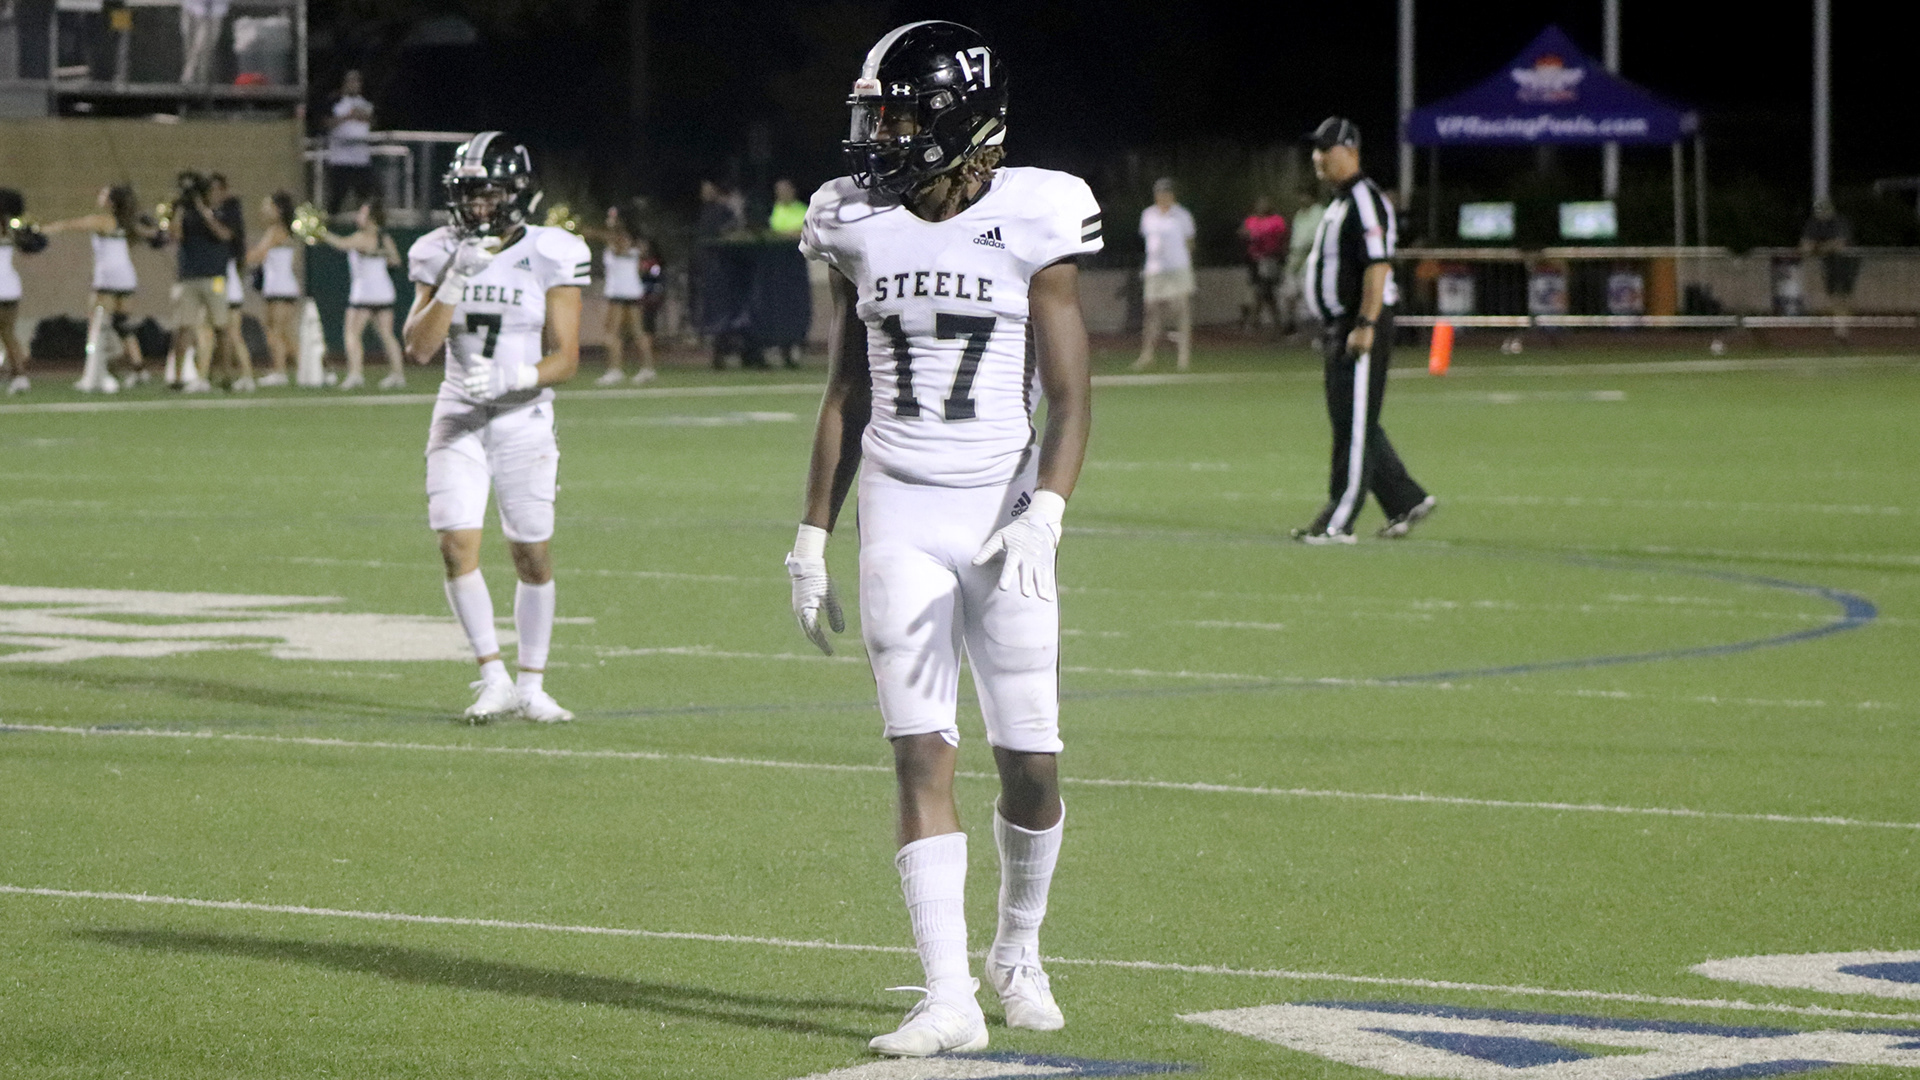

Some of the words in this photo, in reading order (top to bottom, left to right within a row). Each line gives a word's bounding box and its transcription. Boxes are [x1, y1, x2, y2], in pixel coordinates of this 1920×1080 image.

[955, 46, 991, 88] 17
[972, 237, 1006, 249] adidas
[462, 285, 523, 306] TEELE
[875, 271, 993, 302] STEELE
[466, 313, 502, 359] 7
[880, 311, 998, 421] 17
